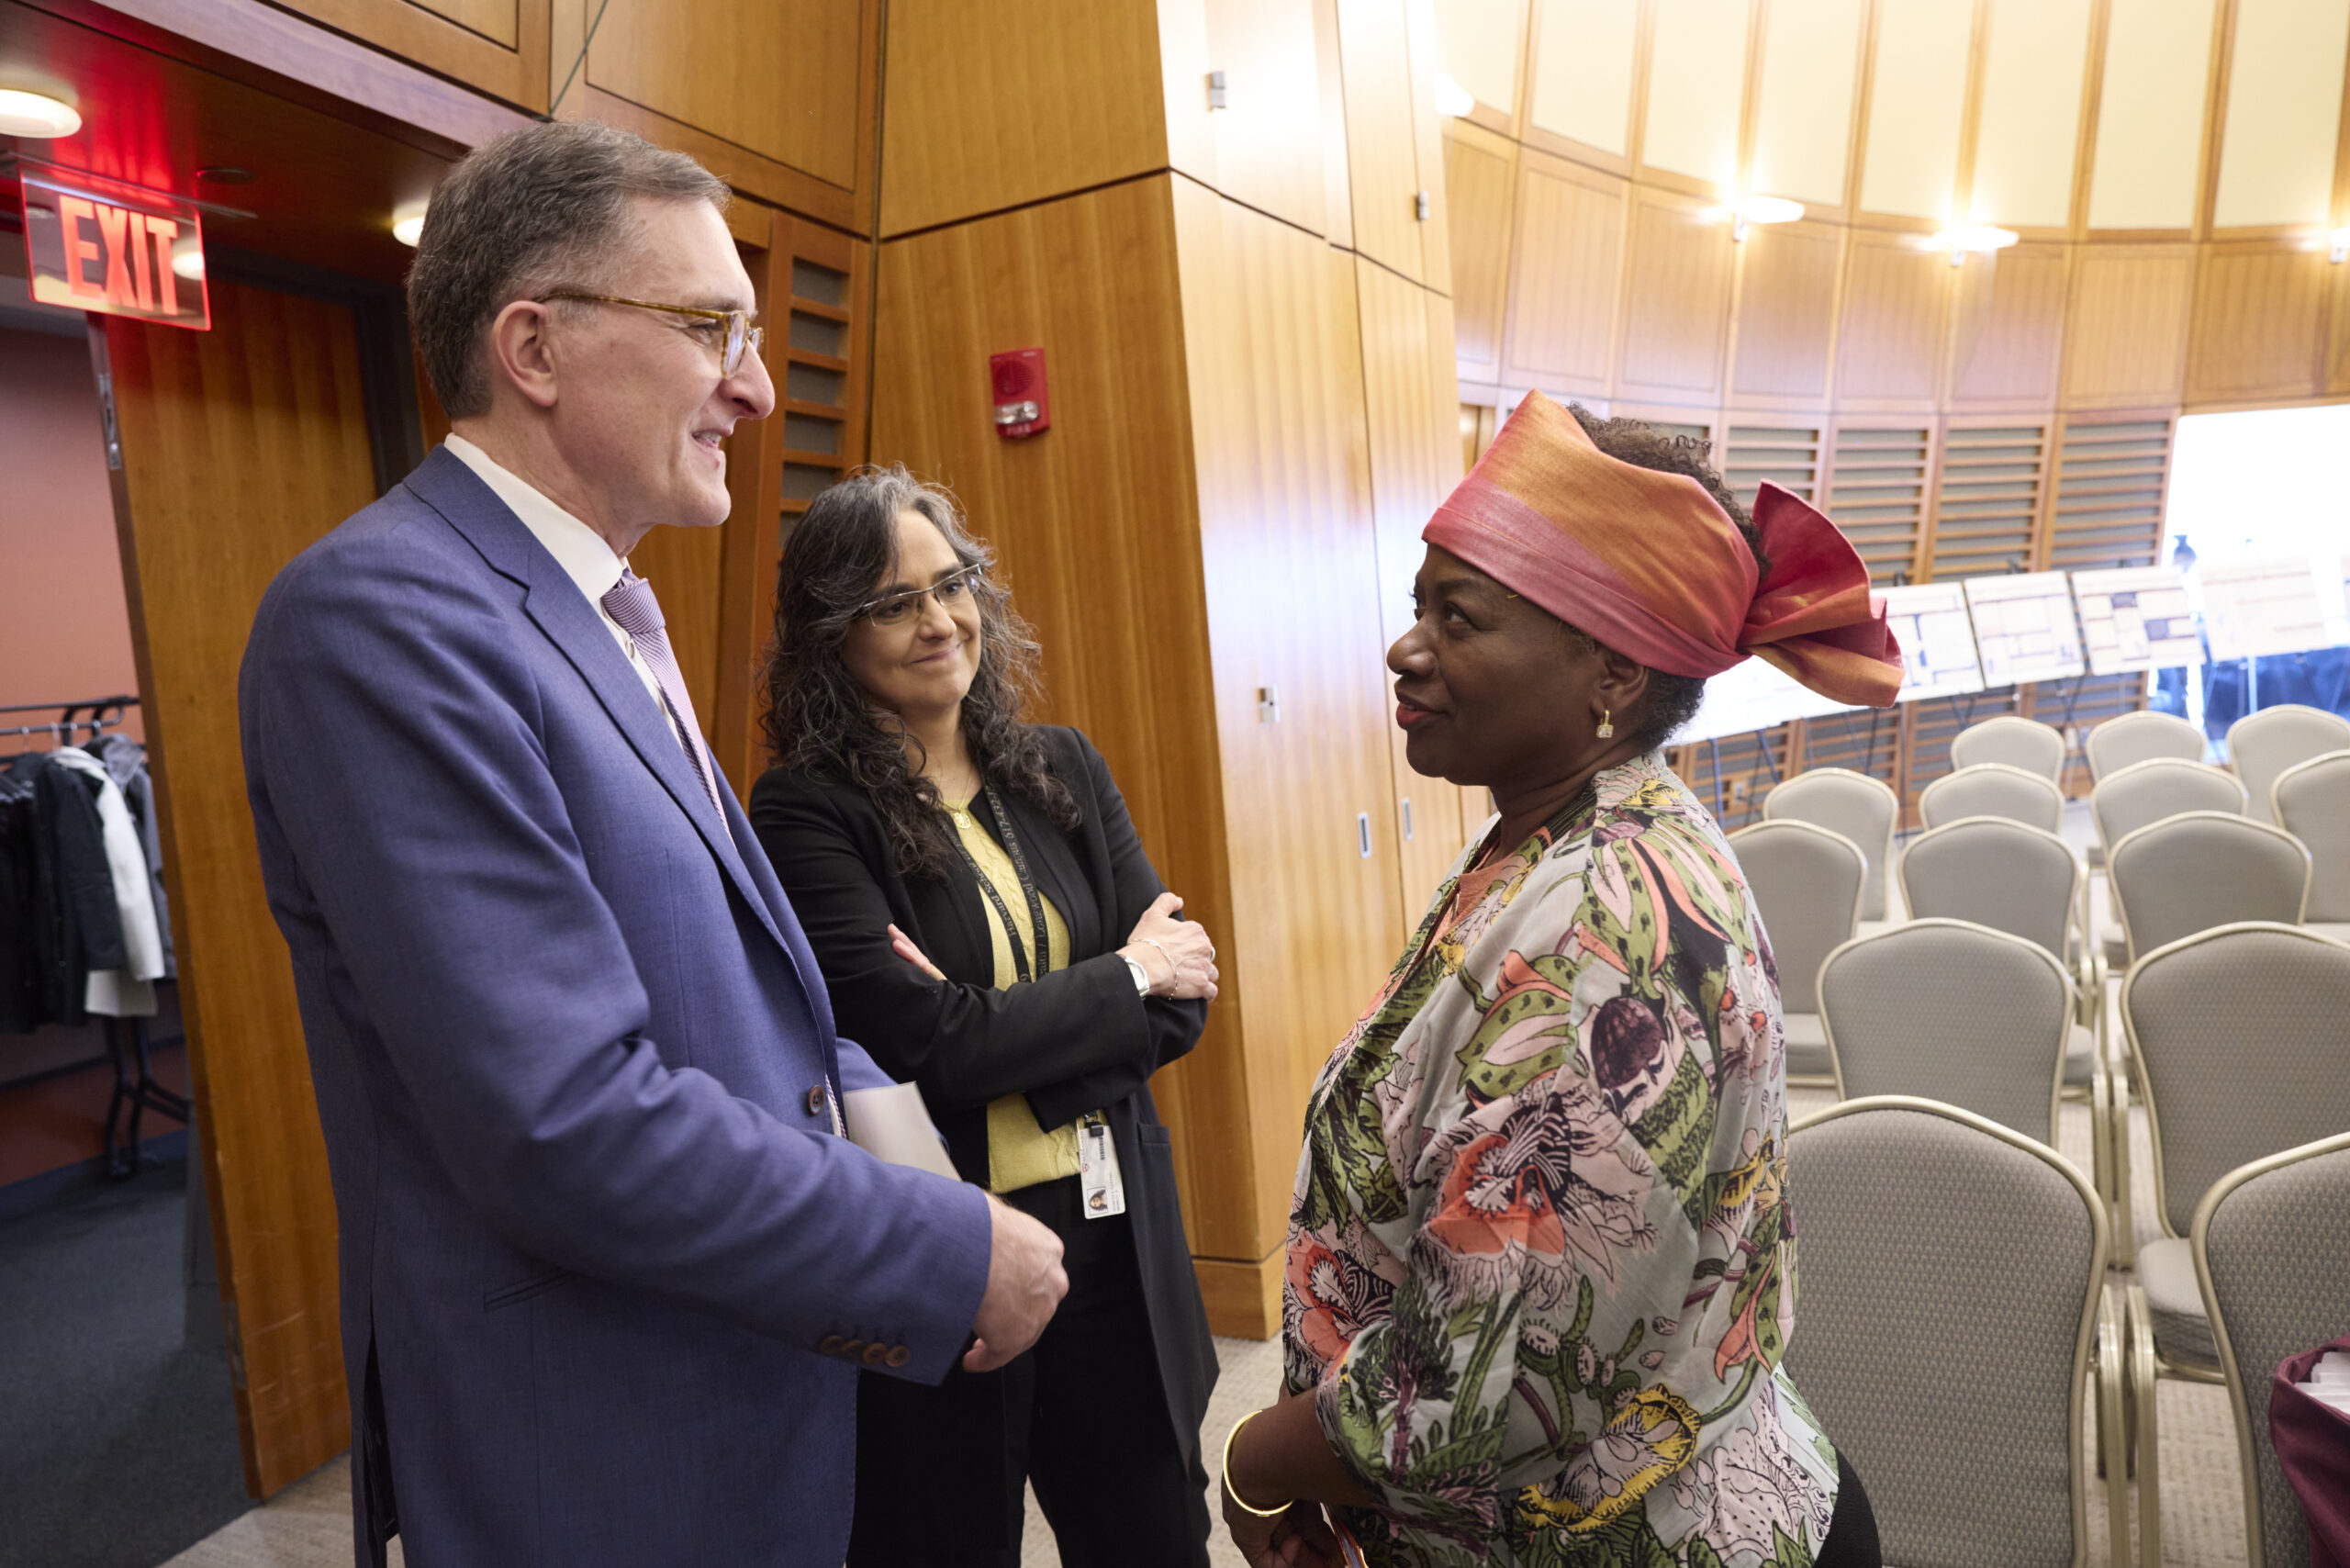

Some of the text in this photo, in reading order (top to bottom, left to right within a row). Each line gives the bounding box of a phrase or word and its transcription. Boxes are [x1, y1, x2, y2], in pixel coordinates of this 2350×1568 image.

[59, 195, 179, 316] EXIT
[968, 862, 994, 893] School
[1009, 842, 1029, 880] Campus
[991, 895, 1017, 935] Harvard
[1023, 883, 1046, 937] Longwood
